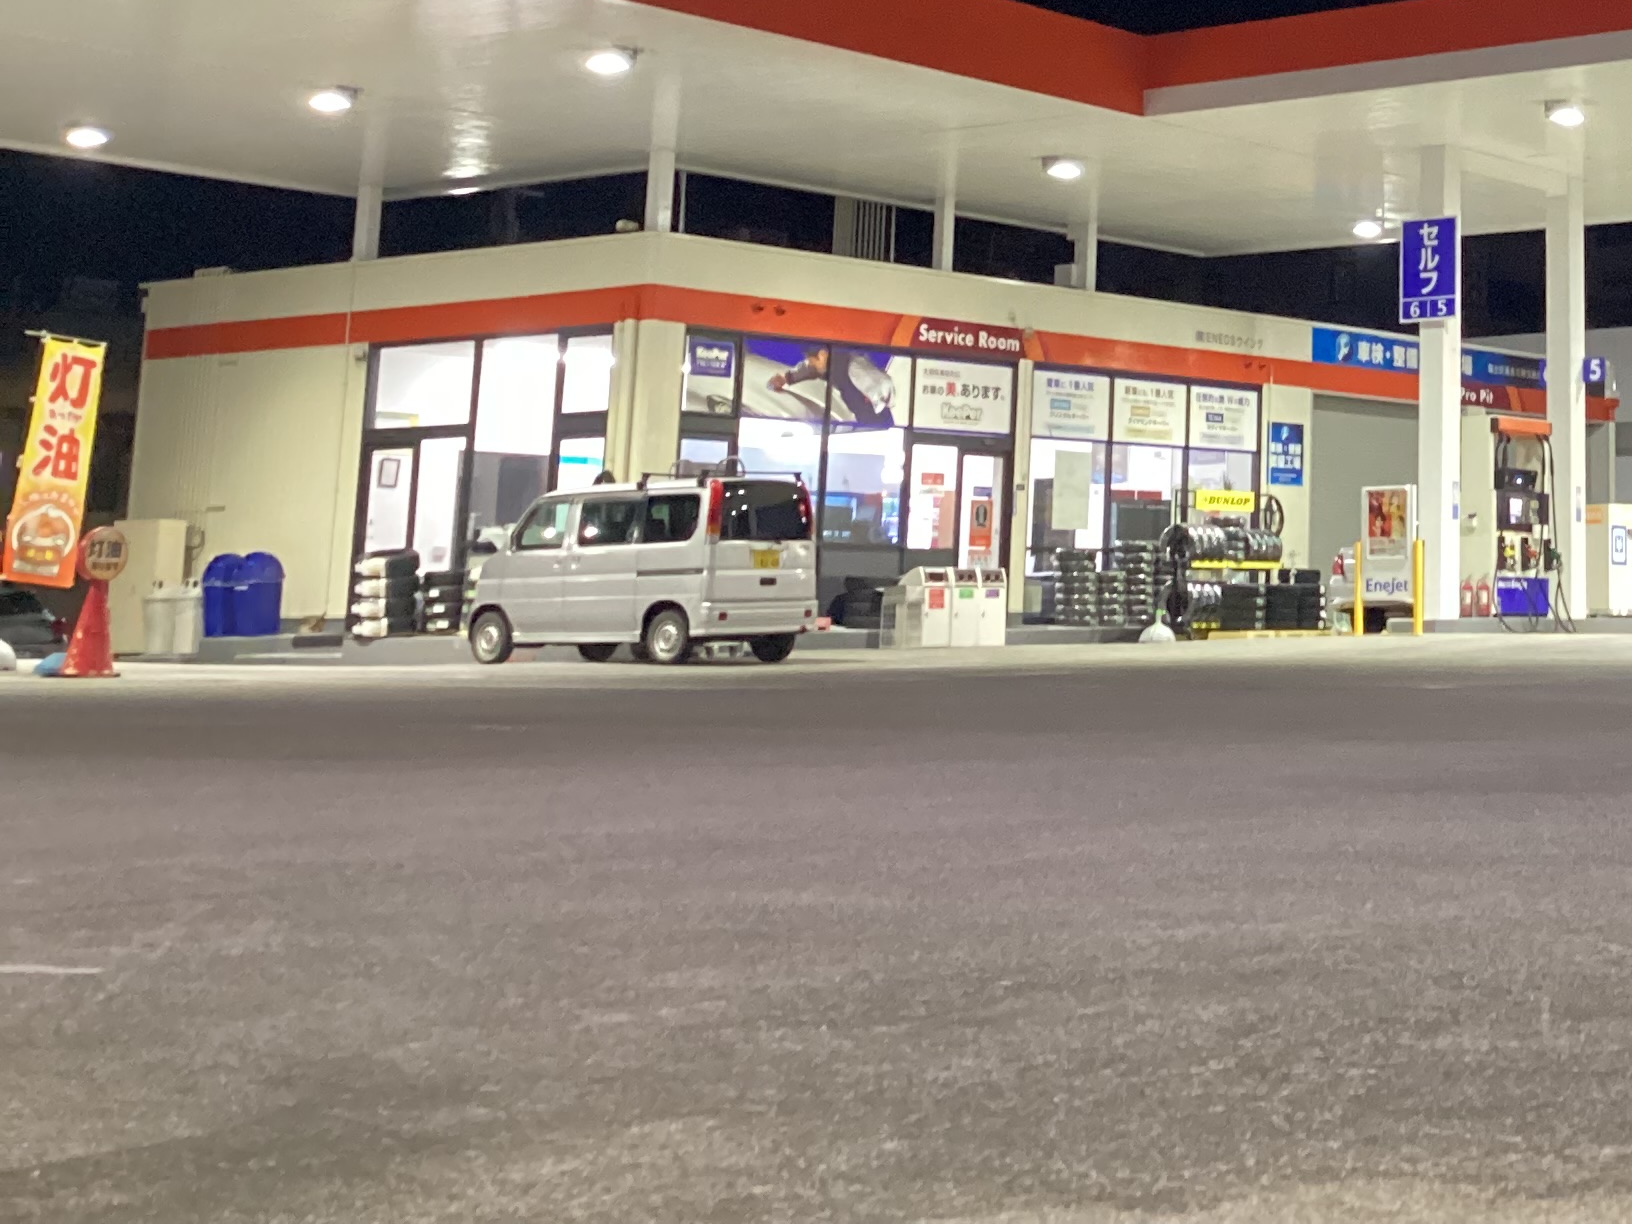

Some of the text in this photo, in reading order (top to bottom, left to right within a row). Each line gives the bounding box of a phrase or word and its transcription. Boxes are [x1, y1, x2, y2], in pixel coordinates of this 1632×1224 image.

[1418, 222, 1440, 295] セルフ
[1409, 299, 1447, 318] 6 5
[918, 323, 1020, 352] Service Room
[1589, 358, 1602, 382] 5
[1480, 388, 1494, 405] Pit
[32, 352, 98, 481] 灯油
[1207, 496, 1251, 506] DUNLOP
